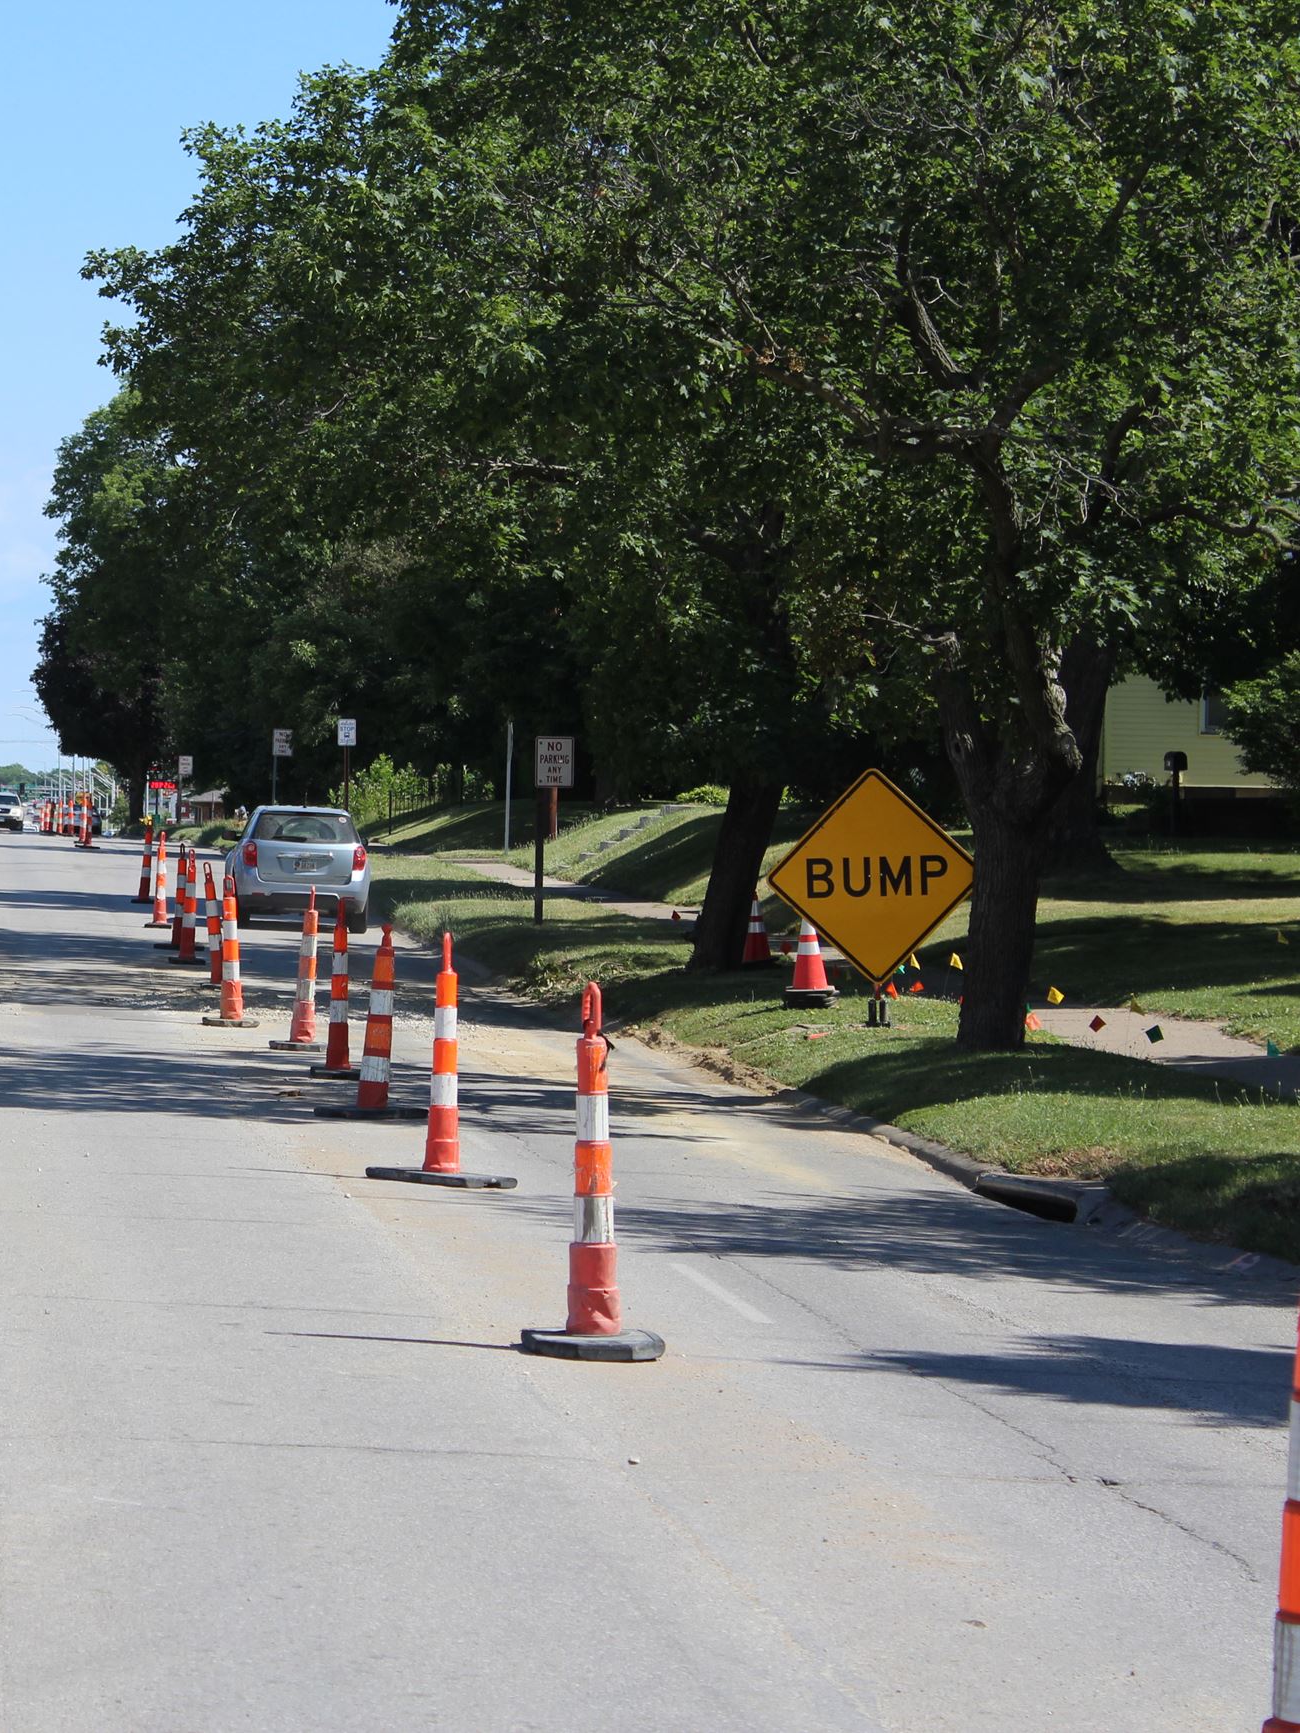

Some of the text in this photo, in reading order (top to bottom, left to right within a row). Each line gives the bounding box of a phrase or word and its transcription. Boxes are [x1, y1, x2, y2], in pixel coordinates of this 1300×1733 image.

[547, 741, 563, 751] NO
[539, 754, 570, 765] PARKING
[547, 766, 562, 774] ANY
[546, 775, 563, 784] TIME
[805, 854, 949, 899] BUMP
